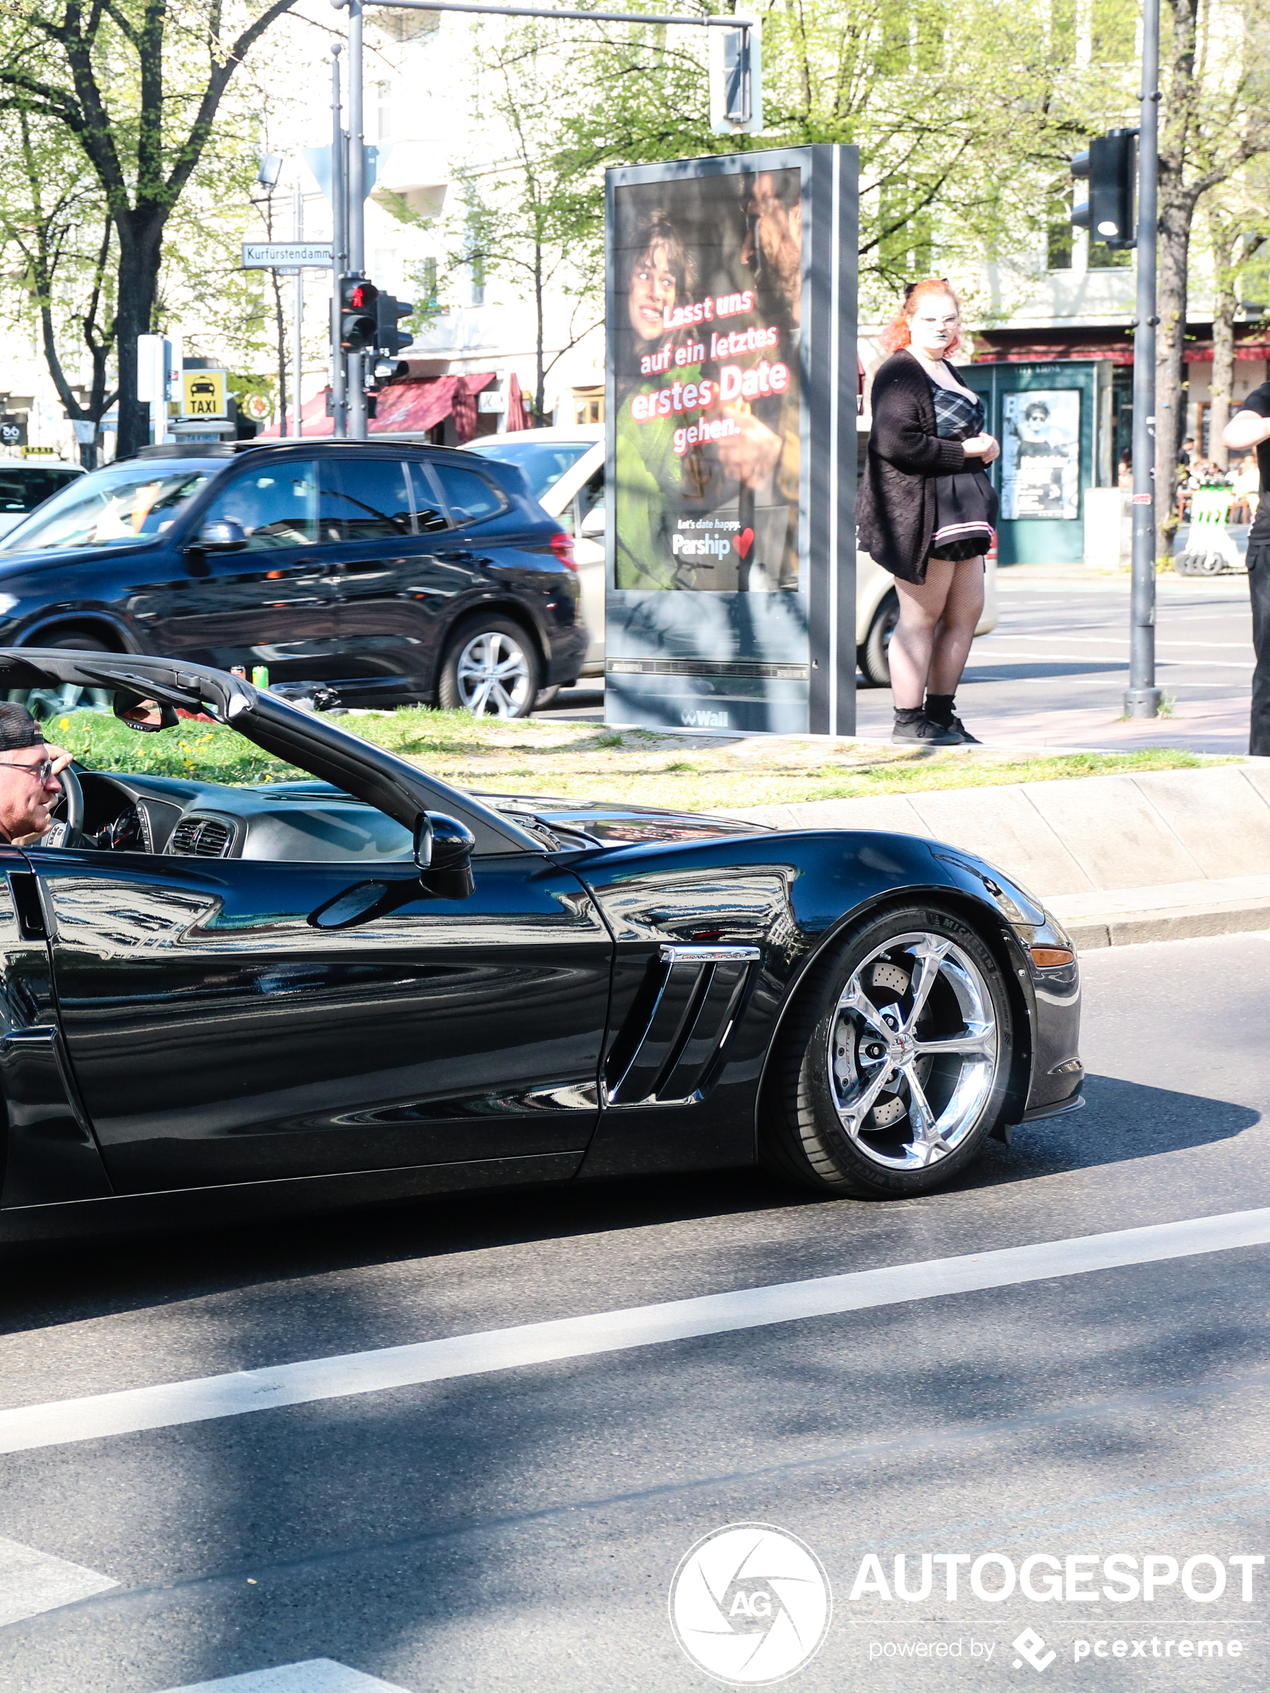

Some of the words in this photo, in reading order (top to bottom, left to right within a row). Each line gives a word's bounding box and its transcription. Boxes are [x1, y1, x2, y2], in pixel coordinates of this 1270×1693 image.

[248, 246, 331, 260] Kurfürstendamm
[663, 297, 713, 330] Lasst
[716, 291, 753, 316] uns
[641, 343, 672, 374] auf
[675, 339, 705, 366] ein
[710, 327, 778, 359] letztes
[190, 400, 216, 413] TAXI
[631, 380, 712, 420] erstes
[719, 361, 788, 403] Date
[673, 417, 741, 454] gehen.
[677, 519, 695, 530] Let's
[696, 519, 713, 529] date
[714, 519, 741, 531] happy.
[672, 533, 730, 560] Parship
[696, 710, 728, 727] Wall
[942, 918, 996, 973] MICHELIN
